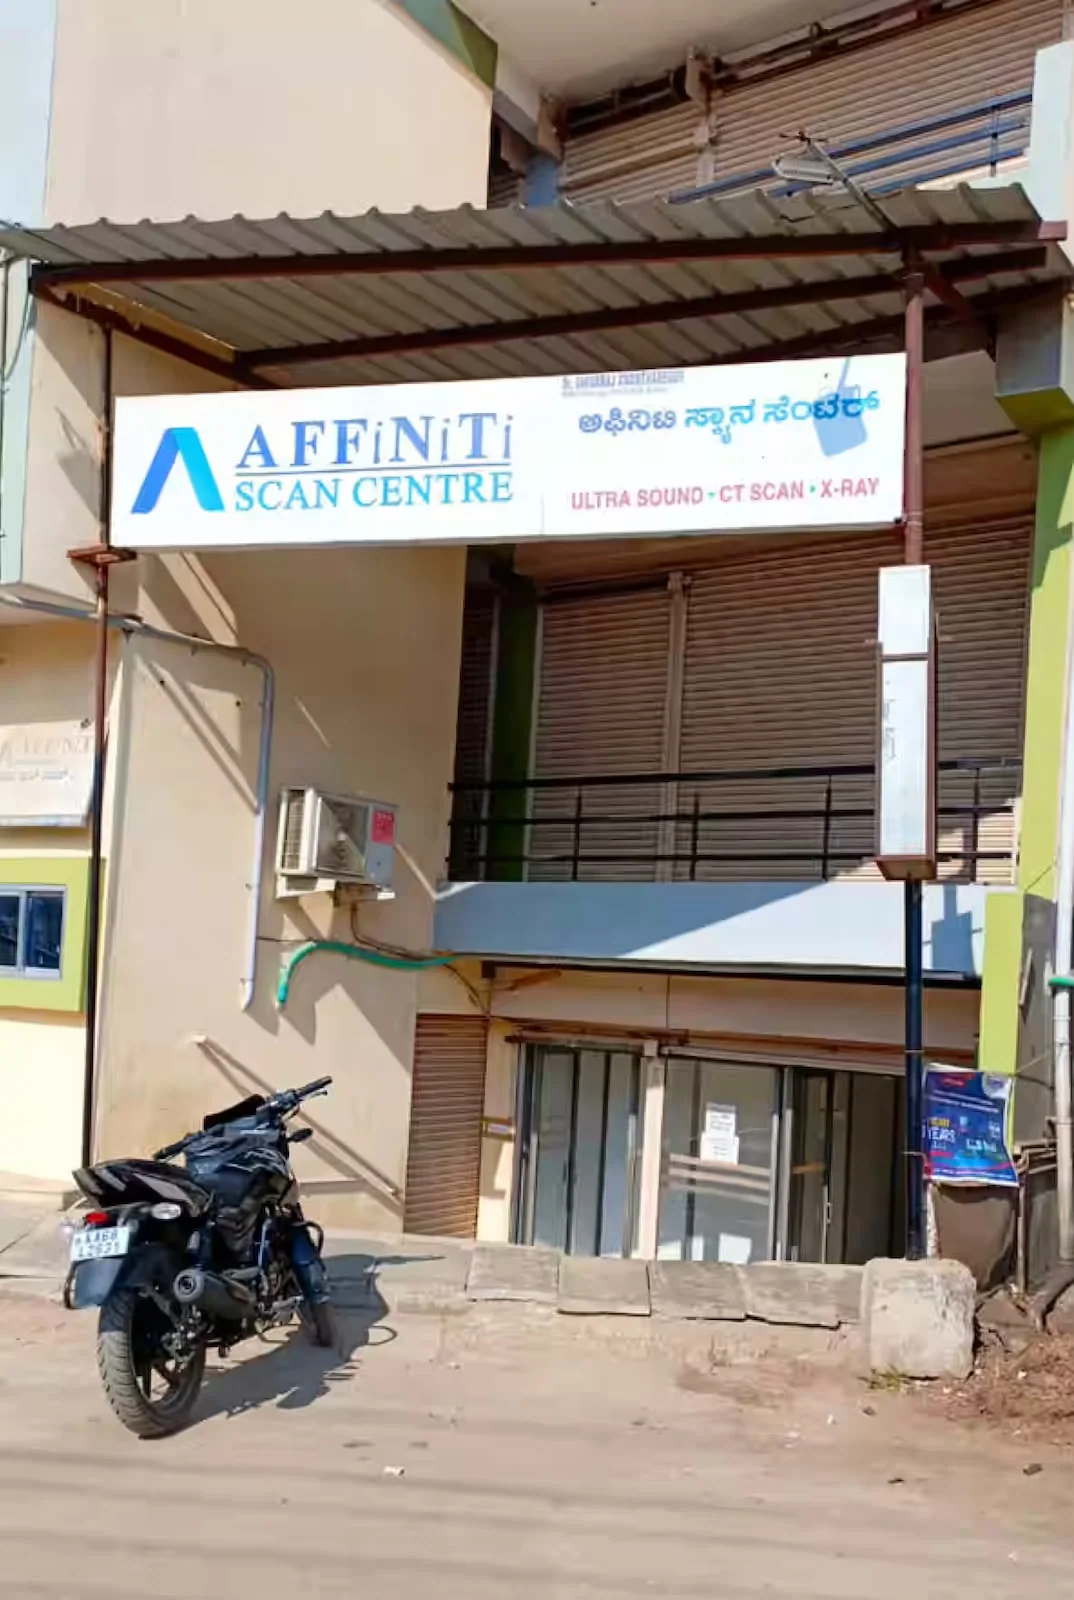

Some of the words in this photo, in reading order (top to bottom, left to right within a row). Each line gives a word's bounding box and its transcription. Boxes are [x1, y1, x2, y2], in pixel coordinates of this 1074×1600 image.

[235, 478, 341, 512] SCAN
[352, 471, 513, 507] CENTRE
[571, 488, 631, 511] ULTRA
[637, 485, 703, 508] SOUND
[719, 483, 746, 503] CT
[750, 479, 804, 502] SCAN
[820, 476, 880, 498] X-RAY
